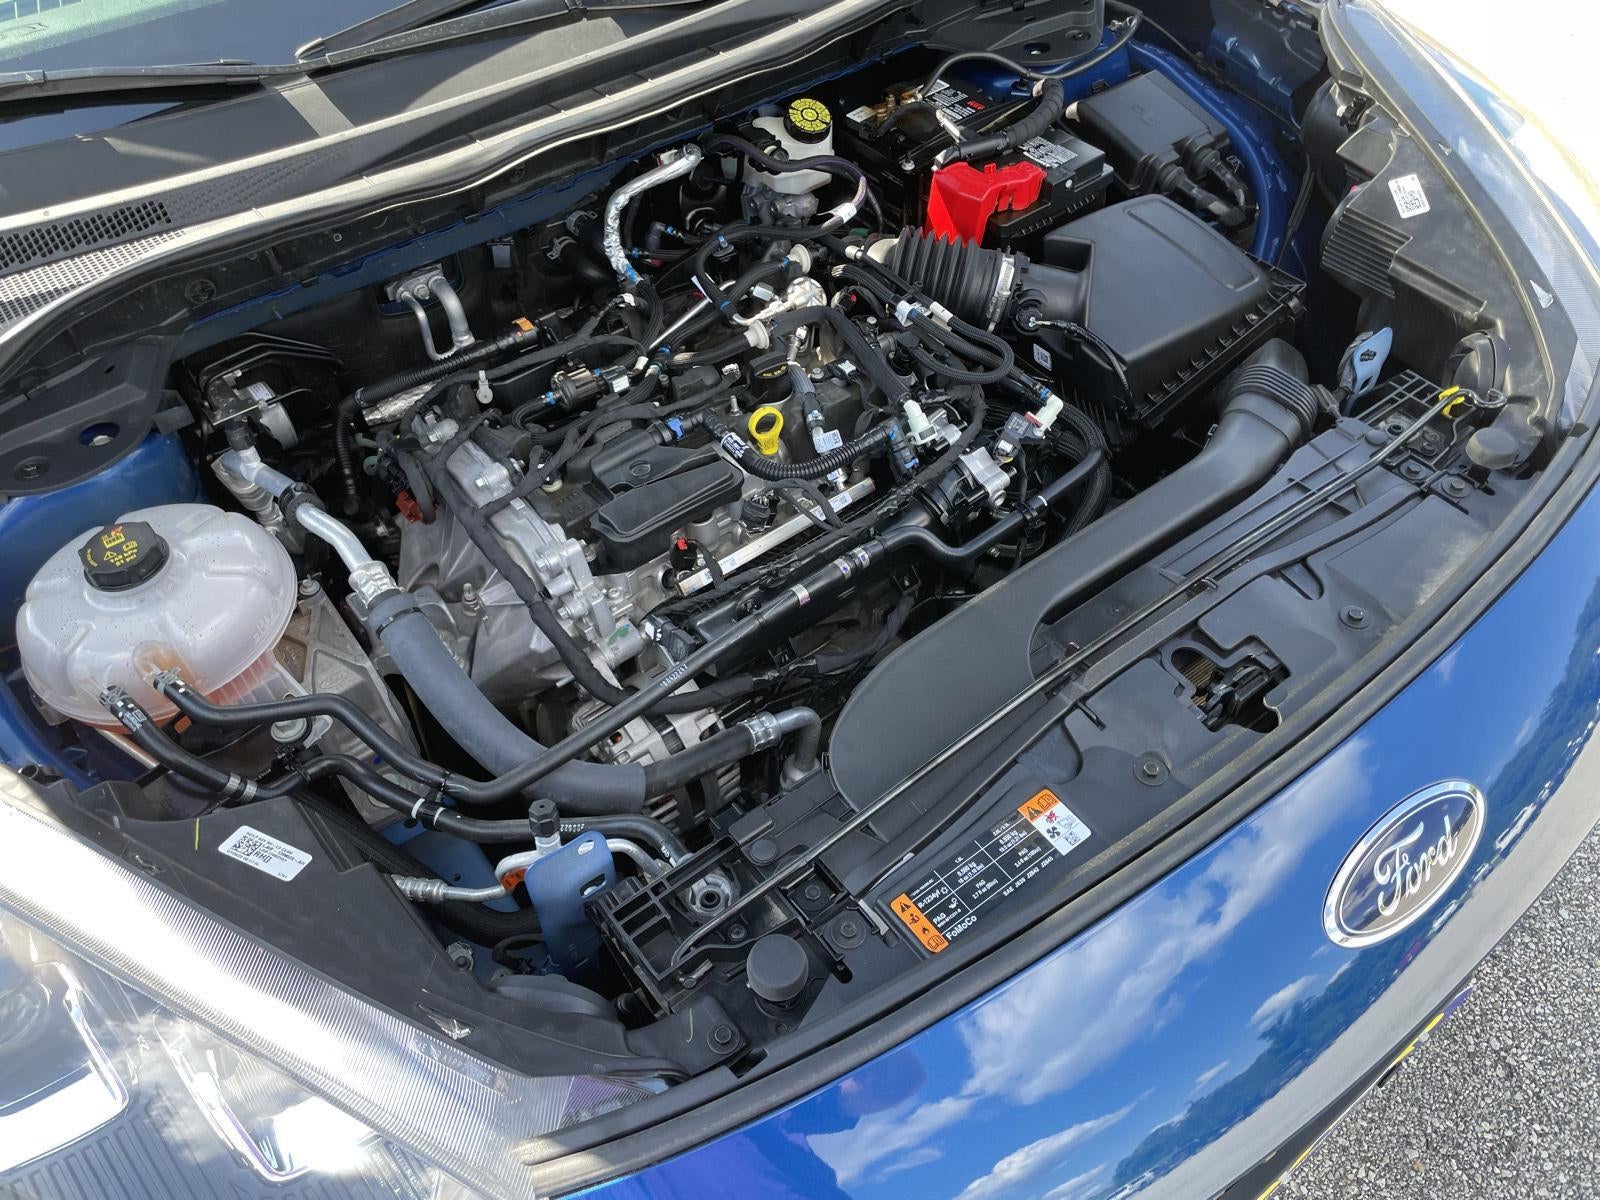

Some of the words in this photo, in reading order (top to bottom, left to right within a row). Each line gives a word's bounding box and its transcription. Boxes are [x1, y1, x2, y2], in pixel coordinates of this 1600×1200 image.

[1018, 848, 1028, 857] PAG
[968, 861, 977, 869] kg
[1373, 814, 1459, 917] Ford
[975, 880, 986, 889] PAG
[1002, 887, 1014, 896] SAE
[1014, 878, 1026, 888] J639
[917, 890, 941, 909] R-1234yf
[932, 912, 946, 925] PAG
[945, 914, 978, 940] FoMoCo
